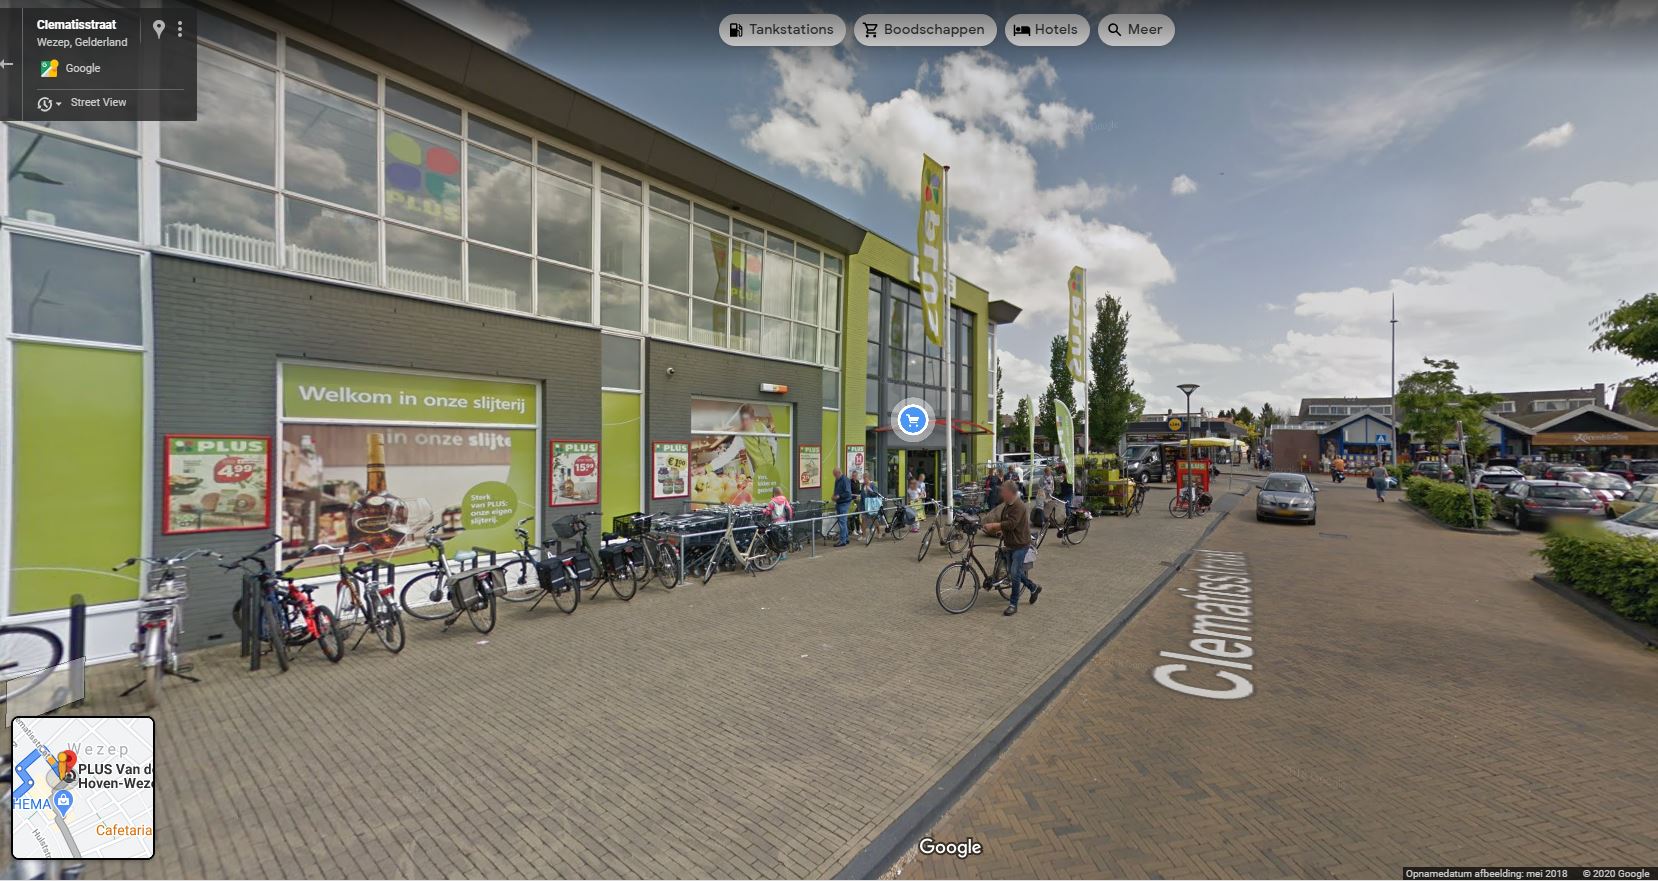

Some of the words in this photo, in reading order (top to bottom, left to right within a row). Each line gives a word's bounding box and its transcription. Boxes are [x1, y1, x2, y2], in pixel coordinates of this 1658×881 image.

[385, 189, 460, 222] PLUS
[298, 385, 393, 405] Welkom
[399, 391, 417, 406] in
[423, 396, 468, 408] onze
[473, 396, 526, 414] slijterij
[386, 428, 407, 445] in
[415, 433, 464, 446] onze
[197, 440, 264, 452] PLUS
[565, 443, 596, 452] PLUS
[663, 444, 687, 452] PLUS
